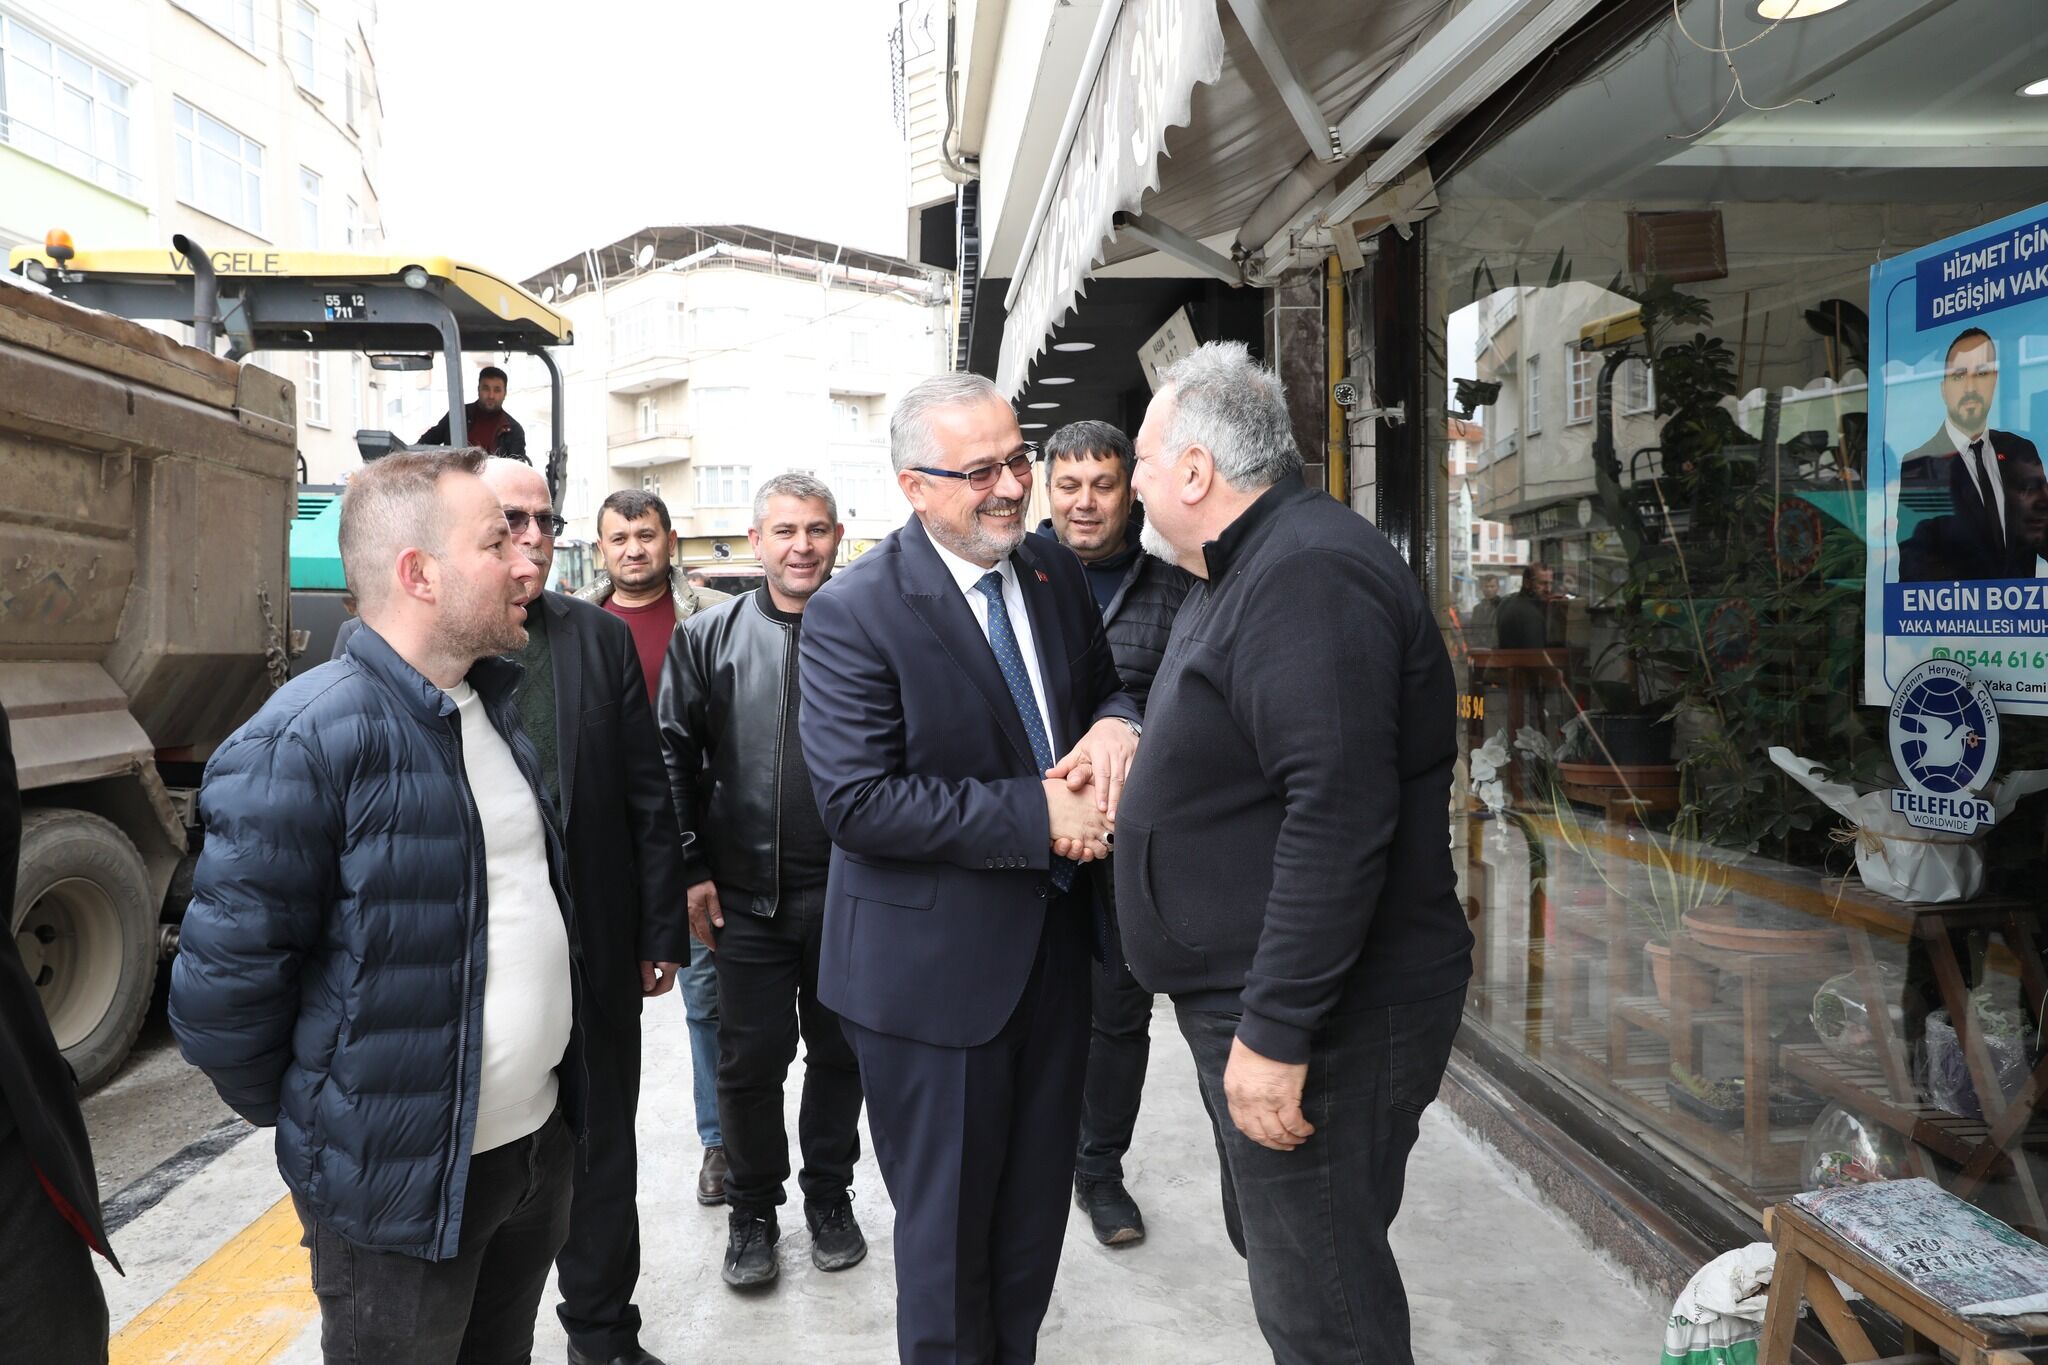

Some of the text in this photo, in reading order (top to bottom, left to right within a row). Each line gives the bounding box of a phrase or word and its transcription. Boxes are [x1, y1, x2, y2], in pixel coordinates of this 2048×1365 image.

[1943, 241, 2010, 282] HİZMET
[325, 295, 365, 307] 55 12
[1933, 278, 2005, 319] DEĞİŞİM
[334, 307, 353, 319] 711
[1903, 581, 1980, 611] ENGİN
[1898, 619, 1933, 633] YAKA
[2007, 650, 2028, 669] 61
[1897, 792, 1989, 822] TELEFLOR
[1913, 814, 1969, 831] WORLDWIDE
